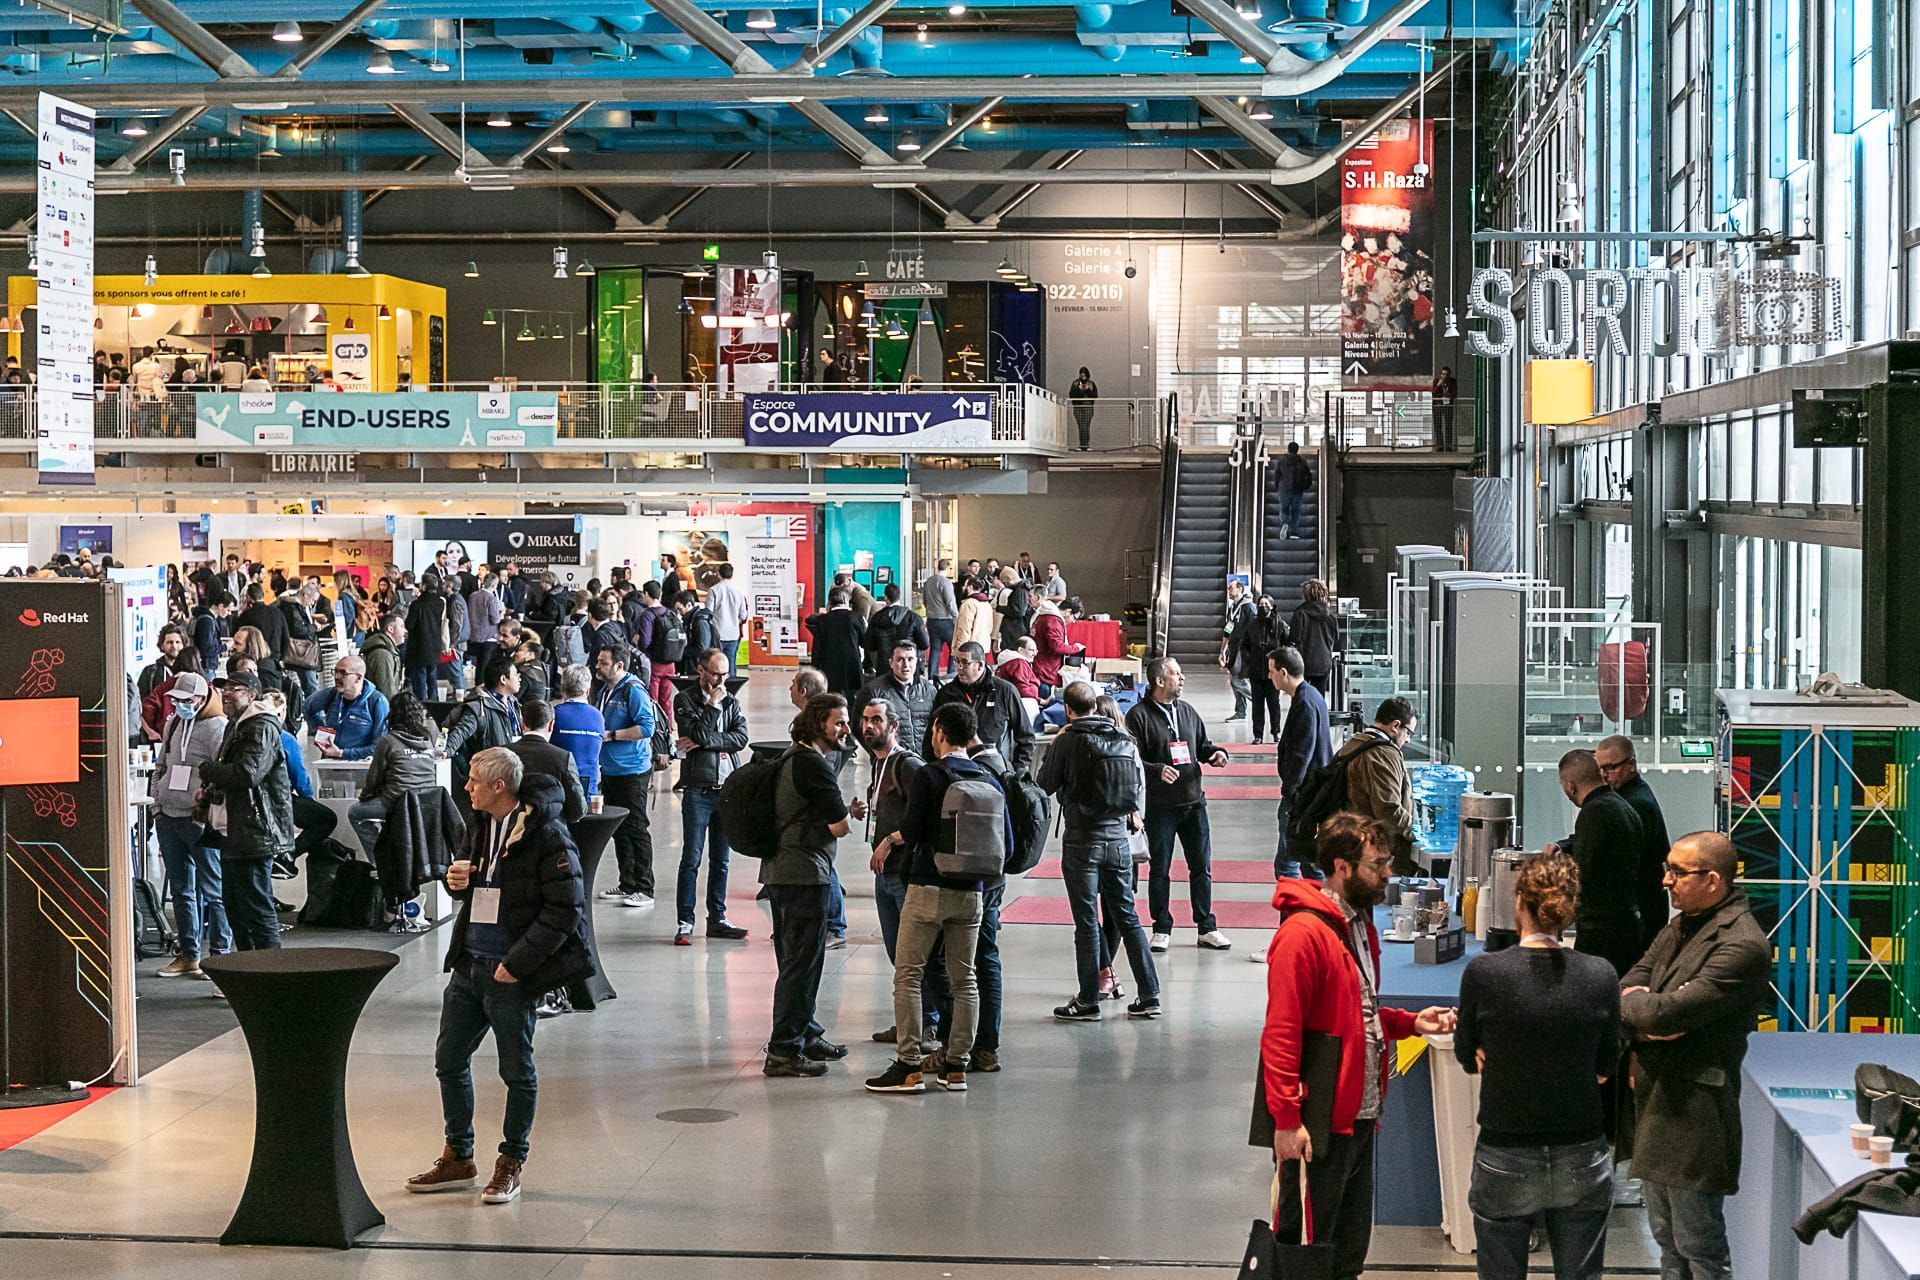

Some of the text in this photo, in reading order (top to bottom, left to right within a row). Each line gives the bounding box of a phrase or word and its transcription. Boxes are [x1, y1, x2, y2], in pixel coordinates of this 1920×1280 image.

[1345, 159, 1372, 167] Exposition
[1383, 171, 1425, 188] Raza
[1064, 244, 1122, 257] Galerie 4
[886, 255, 925, 279] CAFÉ
[1064, 261, 1111, 274] Galerie
[93, 290, 105, 298] os
[107, 290, 149, 299] sponsors
[151, 290, 173, 298] vous
[175, 289, 208, 298] offrent
[210, 289, 218, 298] le
[220, 289, 240, 298] café
[869, 285, 889, 296] café
[1344, 341, 1369, 349] Galerie
[1379, 341, 1400, 350] Gallery
[1401, 341, 1406, 349] 4
[1344, 350, 1369, 358] Niveau
[1378, 350, 1395, 358] Level
[753, 399, 796, 411] Espace
[1177, 383, 1324, 418] GALERIES
[301, 409, 451, 429] END-USERS
[530, 412, 555, 420] deezer
[749, 411, 932, 433] COMMUNITY
[272, 454, 355, 472] LIBRAIRIE
[527, 535, 577, 547] MIRAKL
[495, 553, 578, 565] Développons le futur
[761, 555, 791, 563] cherchez
[43, 612, 89, 623] Red Hat
